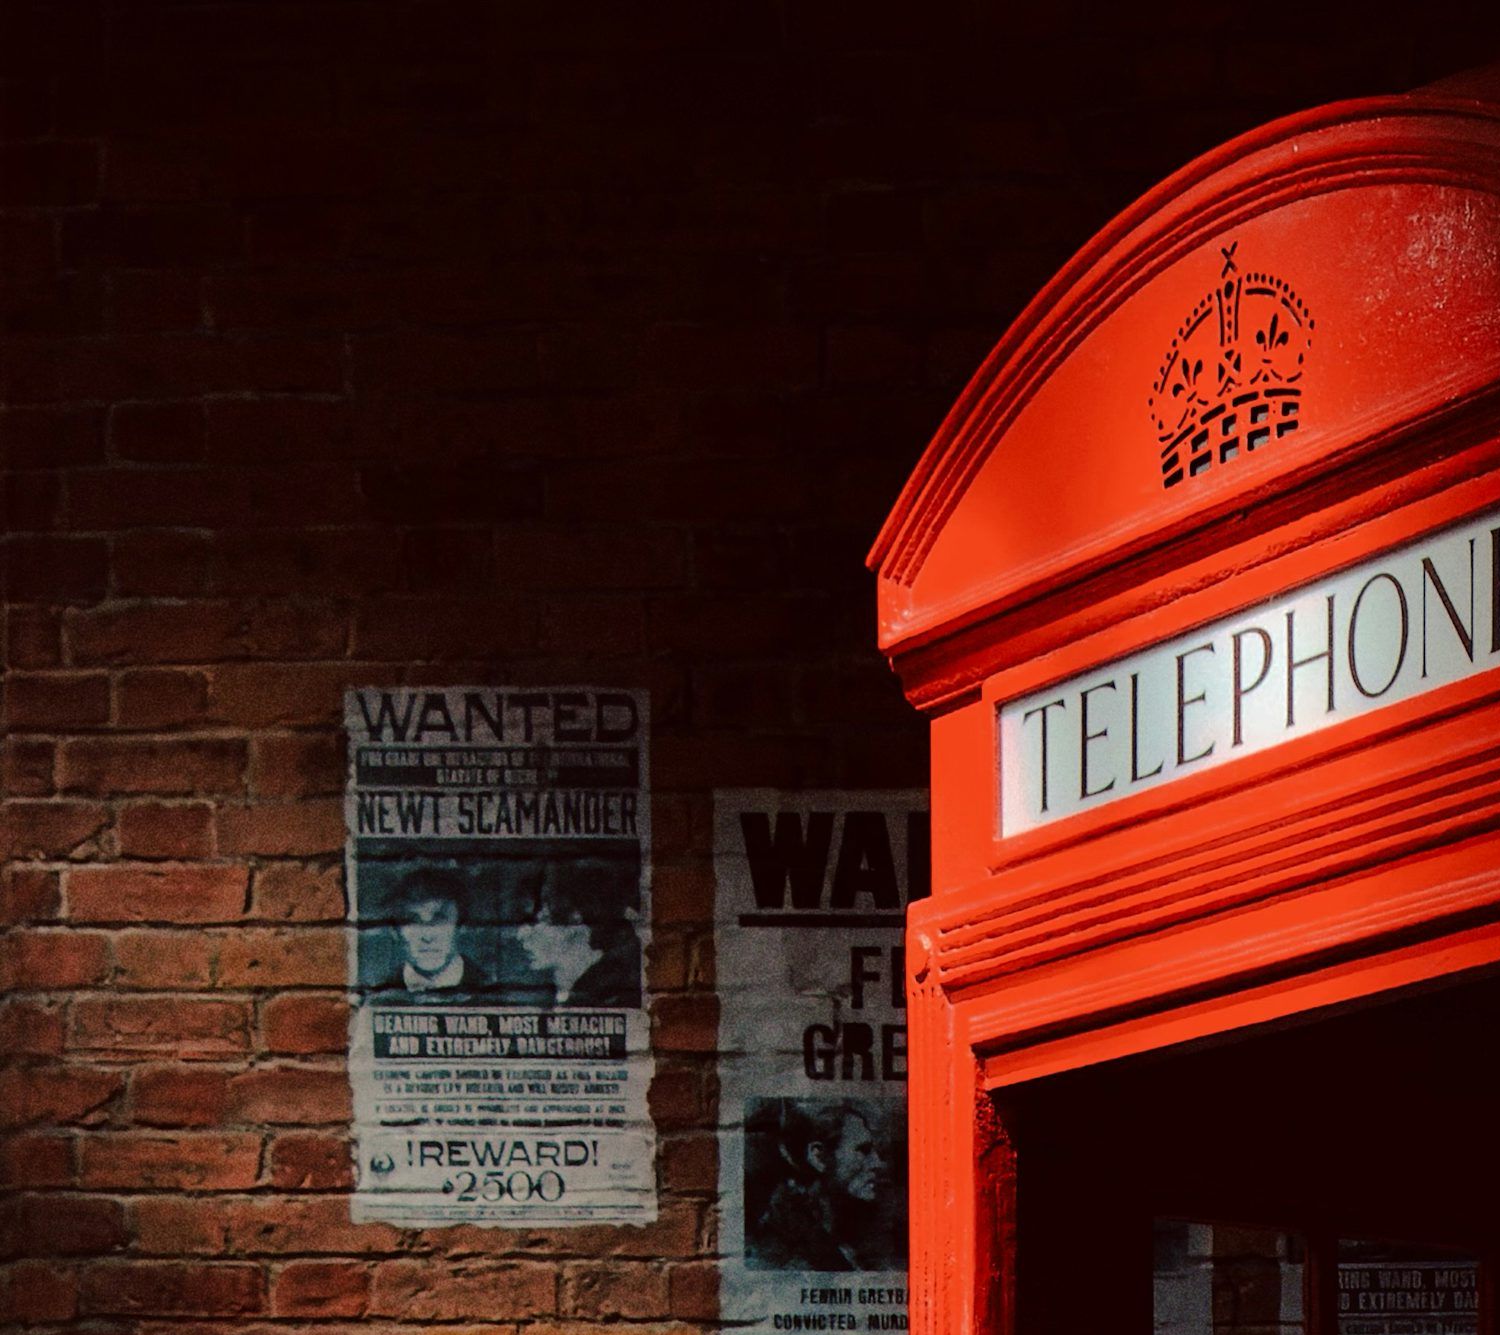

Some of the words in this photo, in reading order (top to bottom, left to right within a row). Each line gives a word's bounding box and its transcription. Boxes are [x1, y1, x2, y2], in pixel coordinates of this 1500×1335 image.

[355, 691, 639, 744] WANTED
[357, 790, 444, 834] NEWT
[457, 791, 638, 835] SCAMANDER
[374, 1013, 441, 1036] BEARING
[499, 1015, 540, 1036] MOST
[547, 1014, 626, 1036] MENACING
[388, 1036, 420, 1056] AND
[426, 1037, 512, 1056] EXTREMELY
[454, 1170, 566, 1202] 2500
[1358, 1291, 1446, 1310] EXTREMELY
[773, 1314, 856, 1330] CONVICTED
